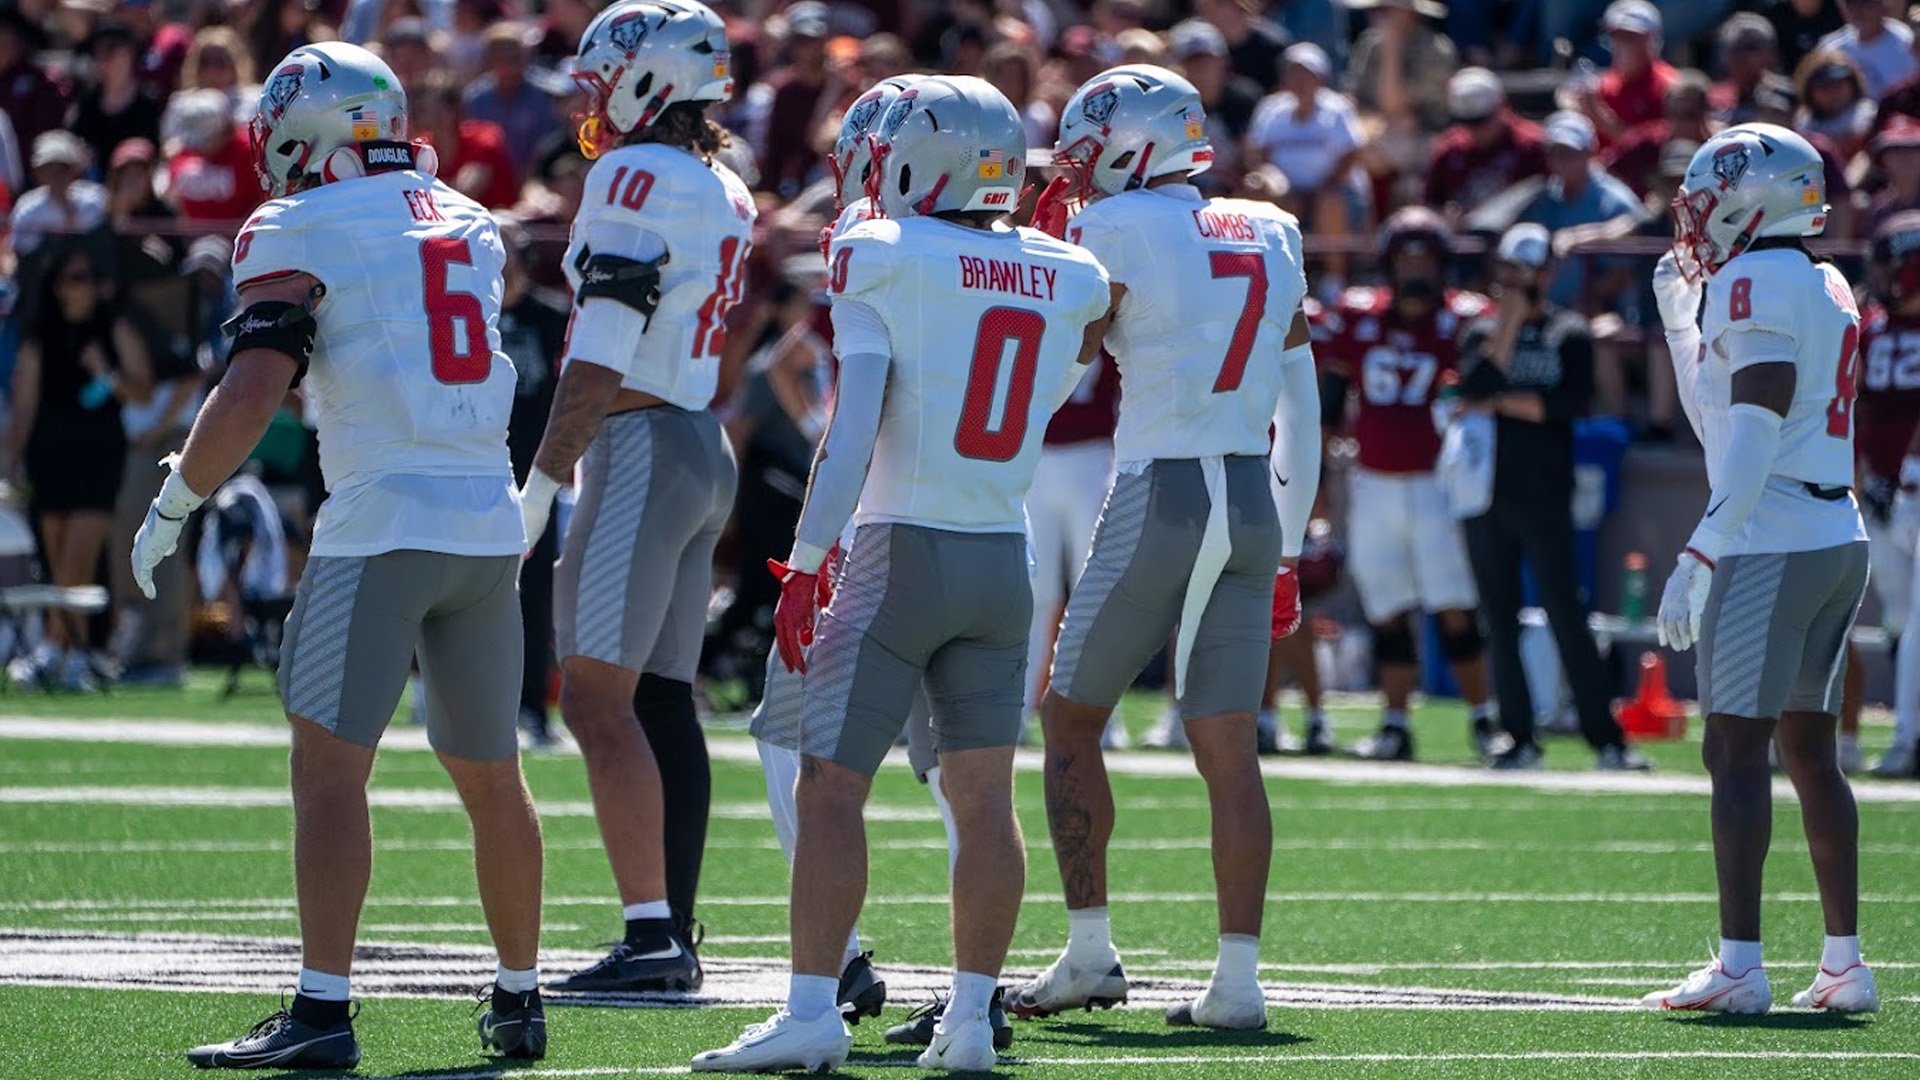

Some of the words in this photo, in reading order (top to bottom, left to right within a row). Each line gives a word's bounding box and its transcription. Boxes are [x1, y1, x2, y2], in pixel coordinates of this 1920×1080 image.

[402, 189, 446, 222] ECK
[607, 166, 656, 212] 10
[1192, 210, 1255, 241] COMBS
[958, 254, 1057, 302] BRAWLEY
[1729, 276, 1753, 322] 8
[419, 232, 494, 385] 6
[1208, 250, 1270, 393] 7
[953, 306, 1047, 462] 0
[1362, 344, 1438, 407] 67
